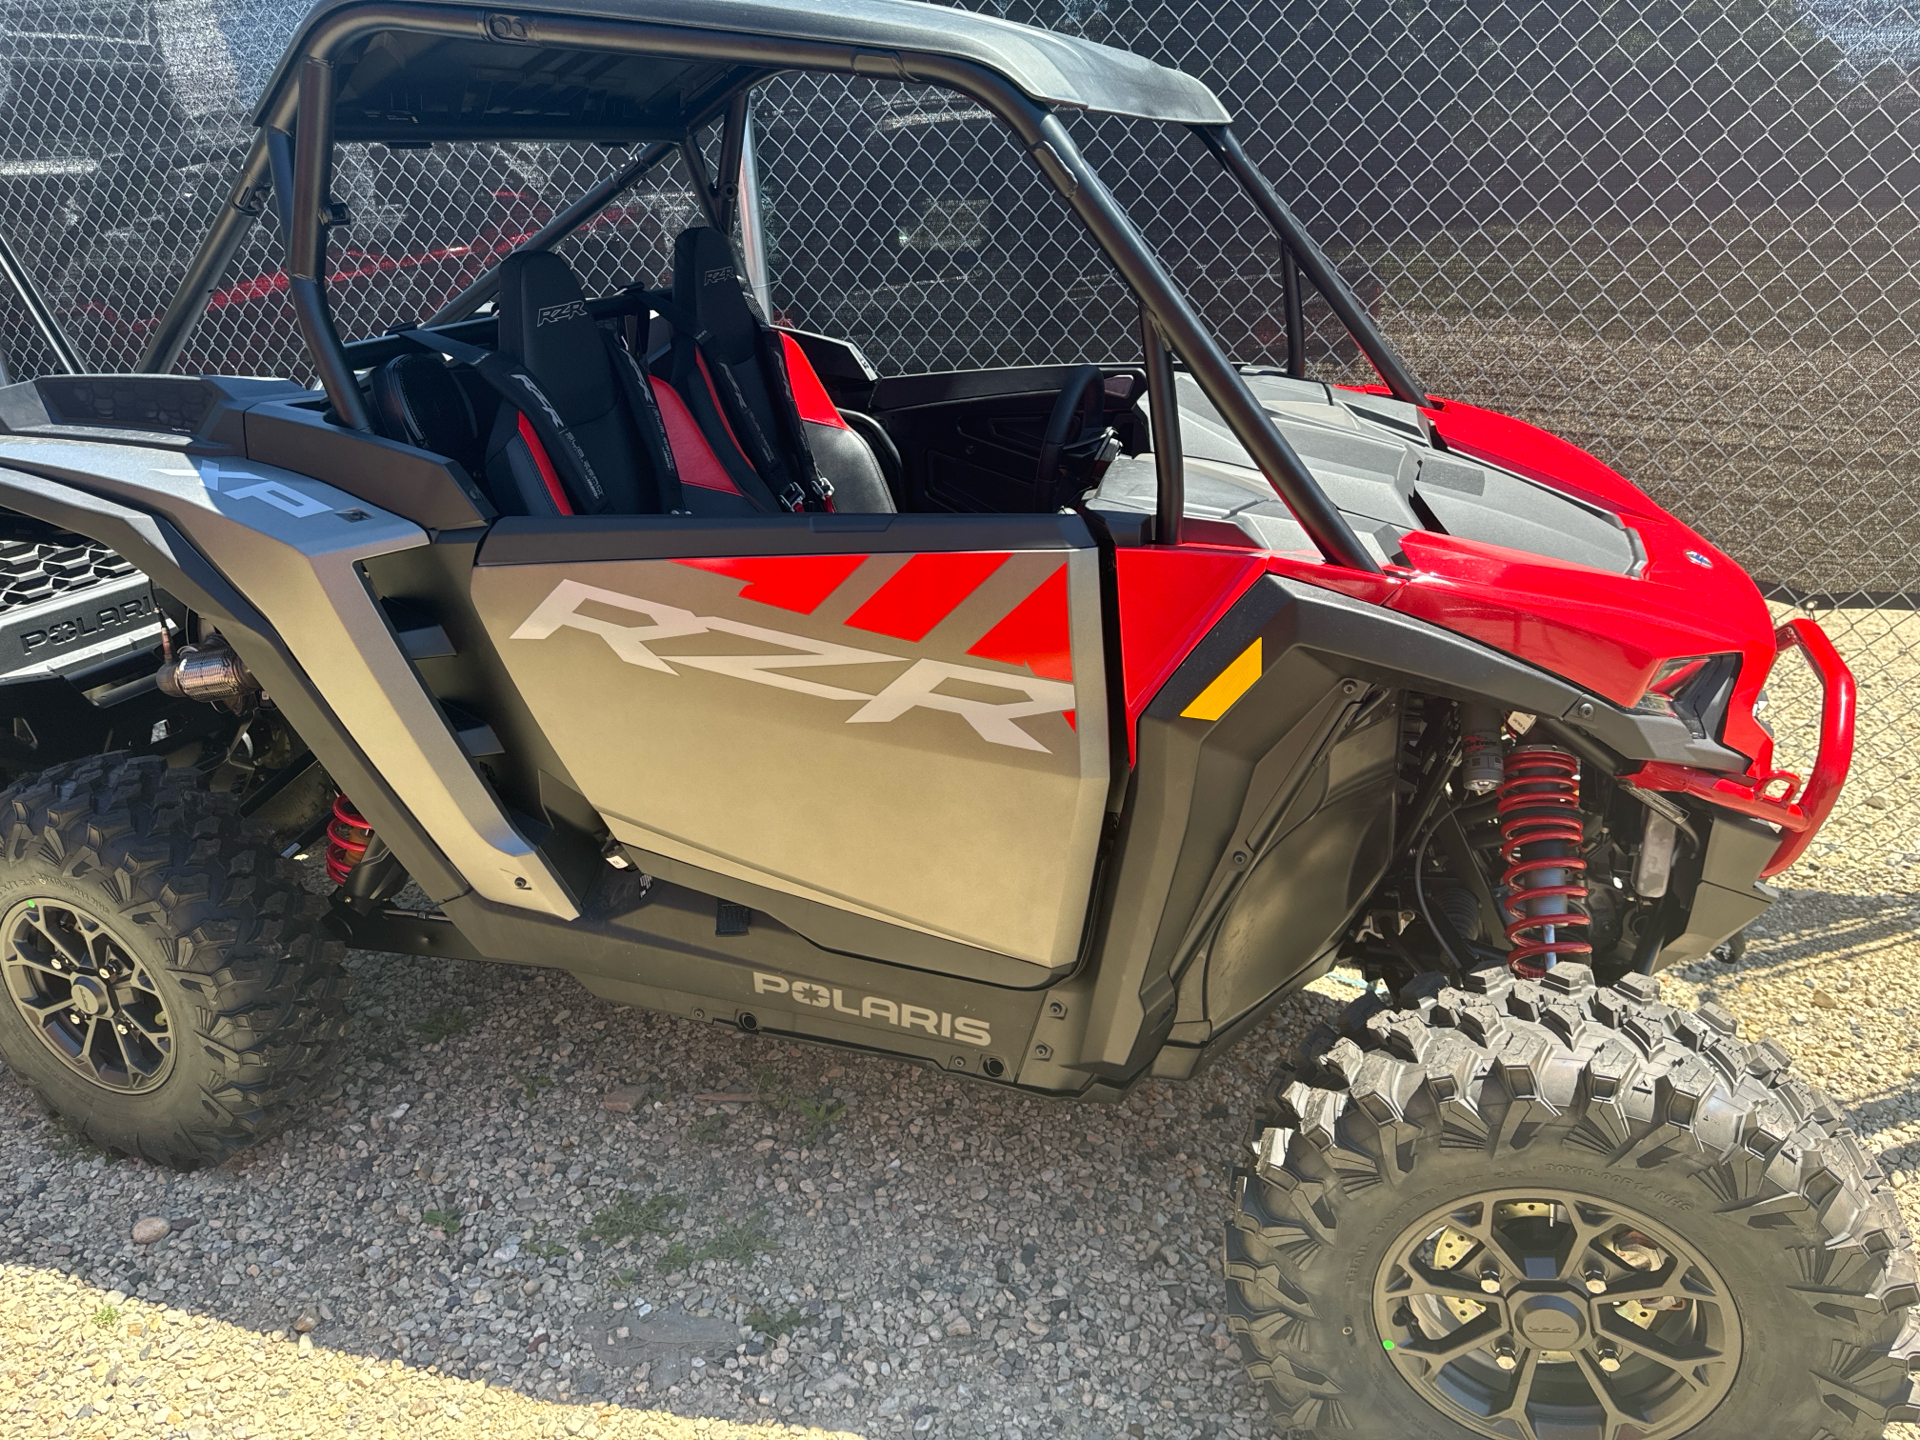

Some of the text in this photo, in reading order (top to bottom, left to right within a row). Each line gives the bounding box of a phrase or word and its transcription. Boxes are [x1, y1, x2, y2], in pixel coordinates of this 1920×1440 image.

[704, 266, 736, 286] RZR
[537, 300, 588, 328] RZR
[510, 374, 564, 428] RZR
[149, 459, 334, 519] XP
[20, 595, 153, 656] POLARI
[509, 578, 1077, 754] RZR
[753, 971, 992, 1047] POLARIS
[1653, 1189, 1694, 1212] NHS
